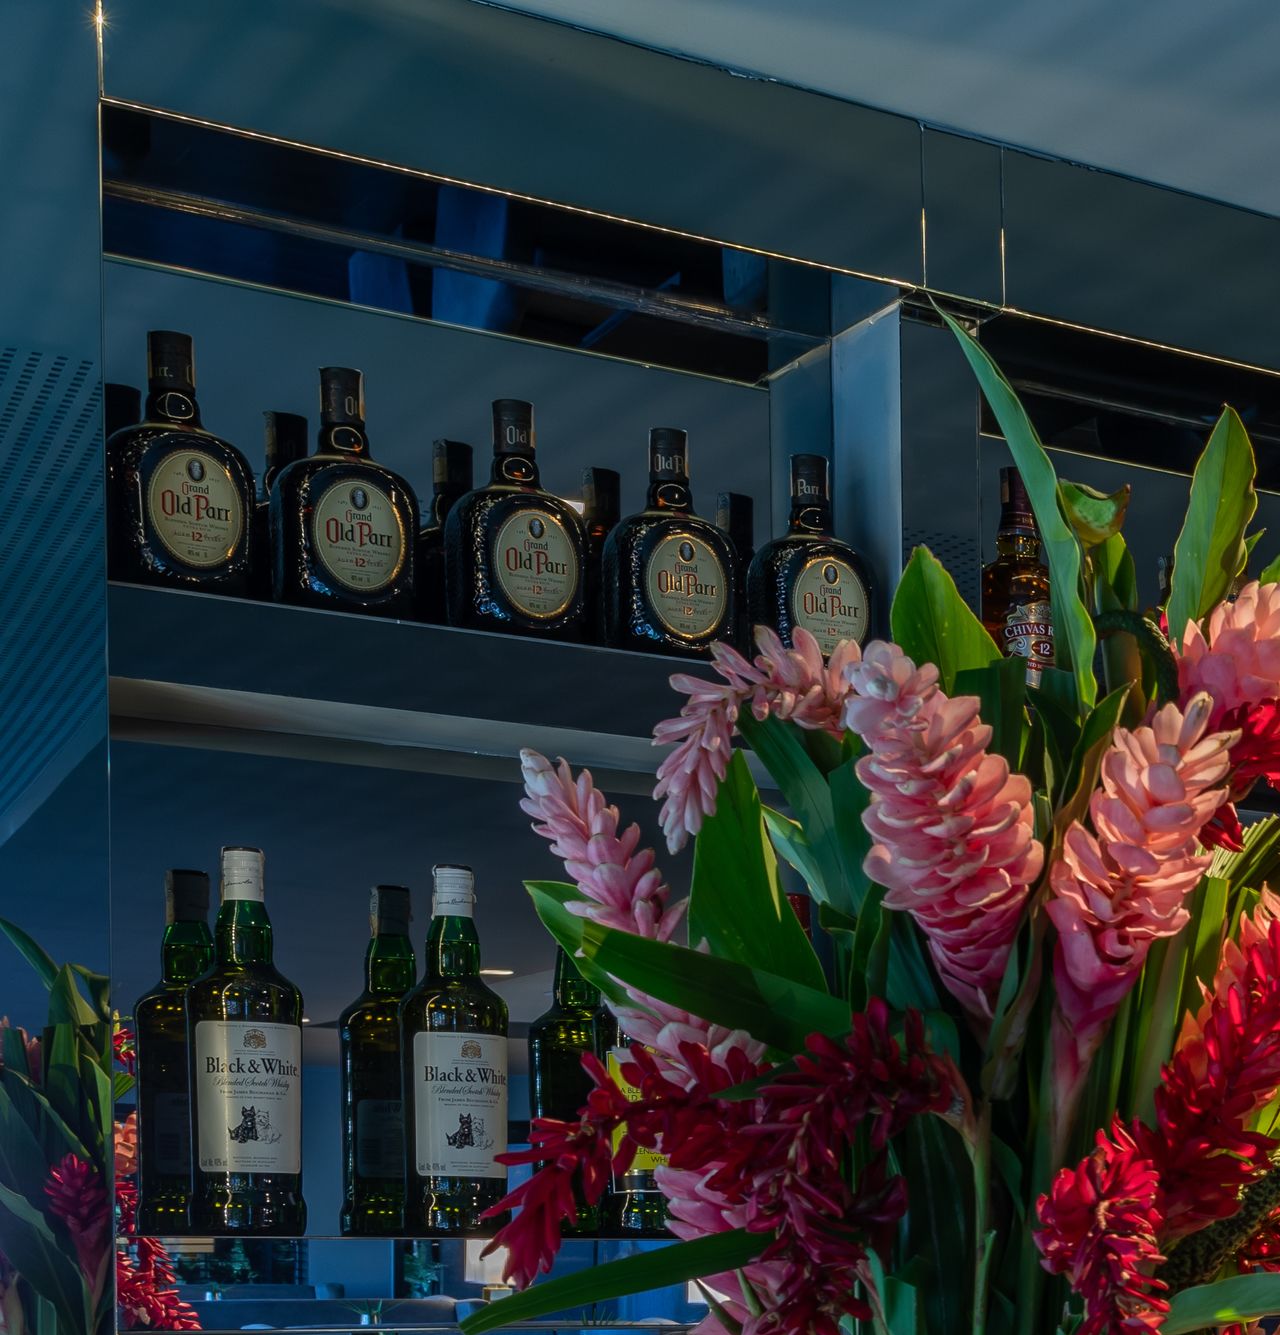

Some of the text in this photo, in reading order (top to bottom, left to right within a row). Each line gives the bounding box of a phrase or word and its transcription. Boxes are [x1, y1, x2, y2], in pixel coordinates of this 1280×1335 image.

[506, 425, 527, 444] Old
[654, 453, 672, 473] Old
[182, 482, 209, 495] Grand
[162, 490, 231, 521] Old Parr
[346, 509, 372, 523] Grand
[192, 532, 203, 542] 12
[326, 518, 392, 548] Old Parr
[524, 539, 548, 551] Grand
[355, 557, 365, 567] 12
[506, 547, 567, 576] Old Parr
[675, 562, 697, 574] Grand
[532, 585, 542, 594] 12
[658, 570, 716, 597] Old Parr
[820, 585, 842, 595] Grand
[803, 592, 860, 619] Old Parr
[1004, 624, 1045, 638] CHIVAS
